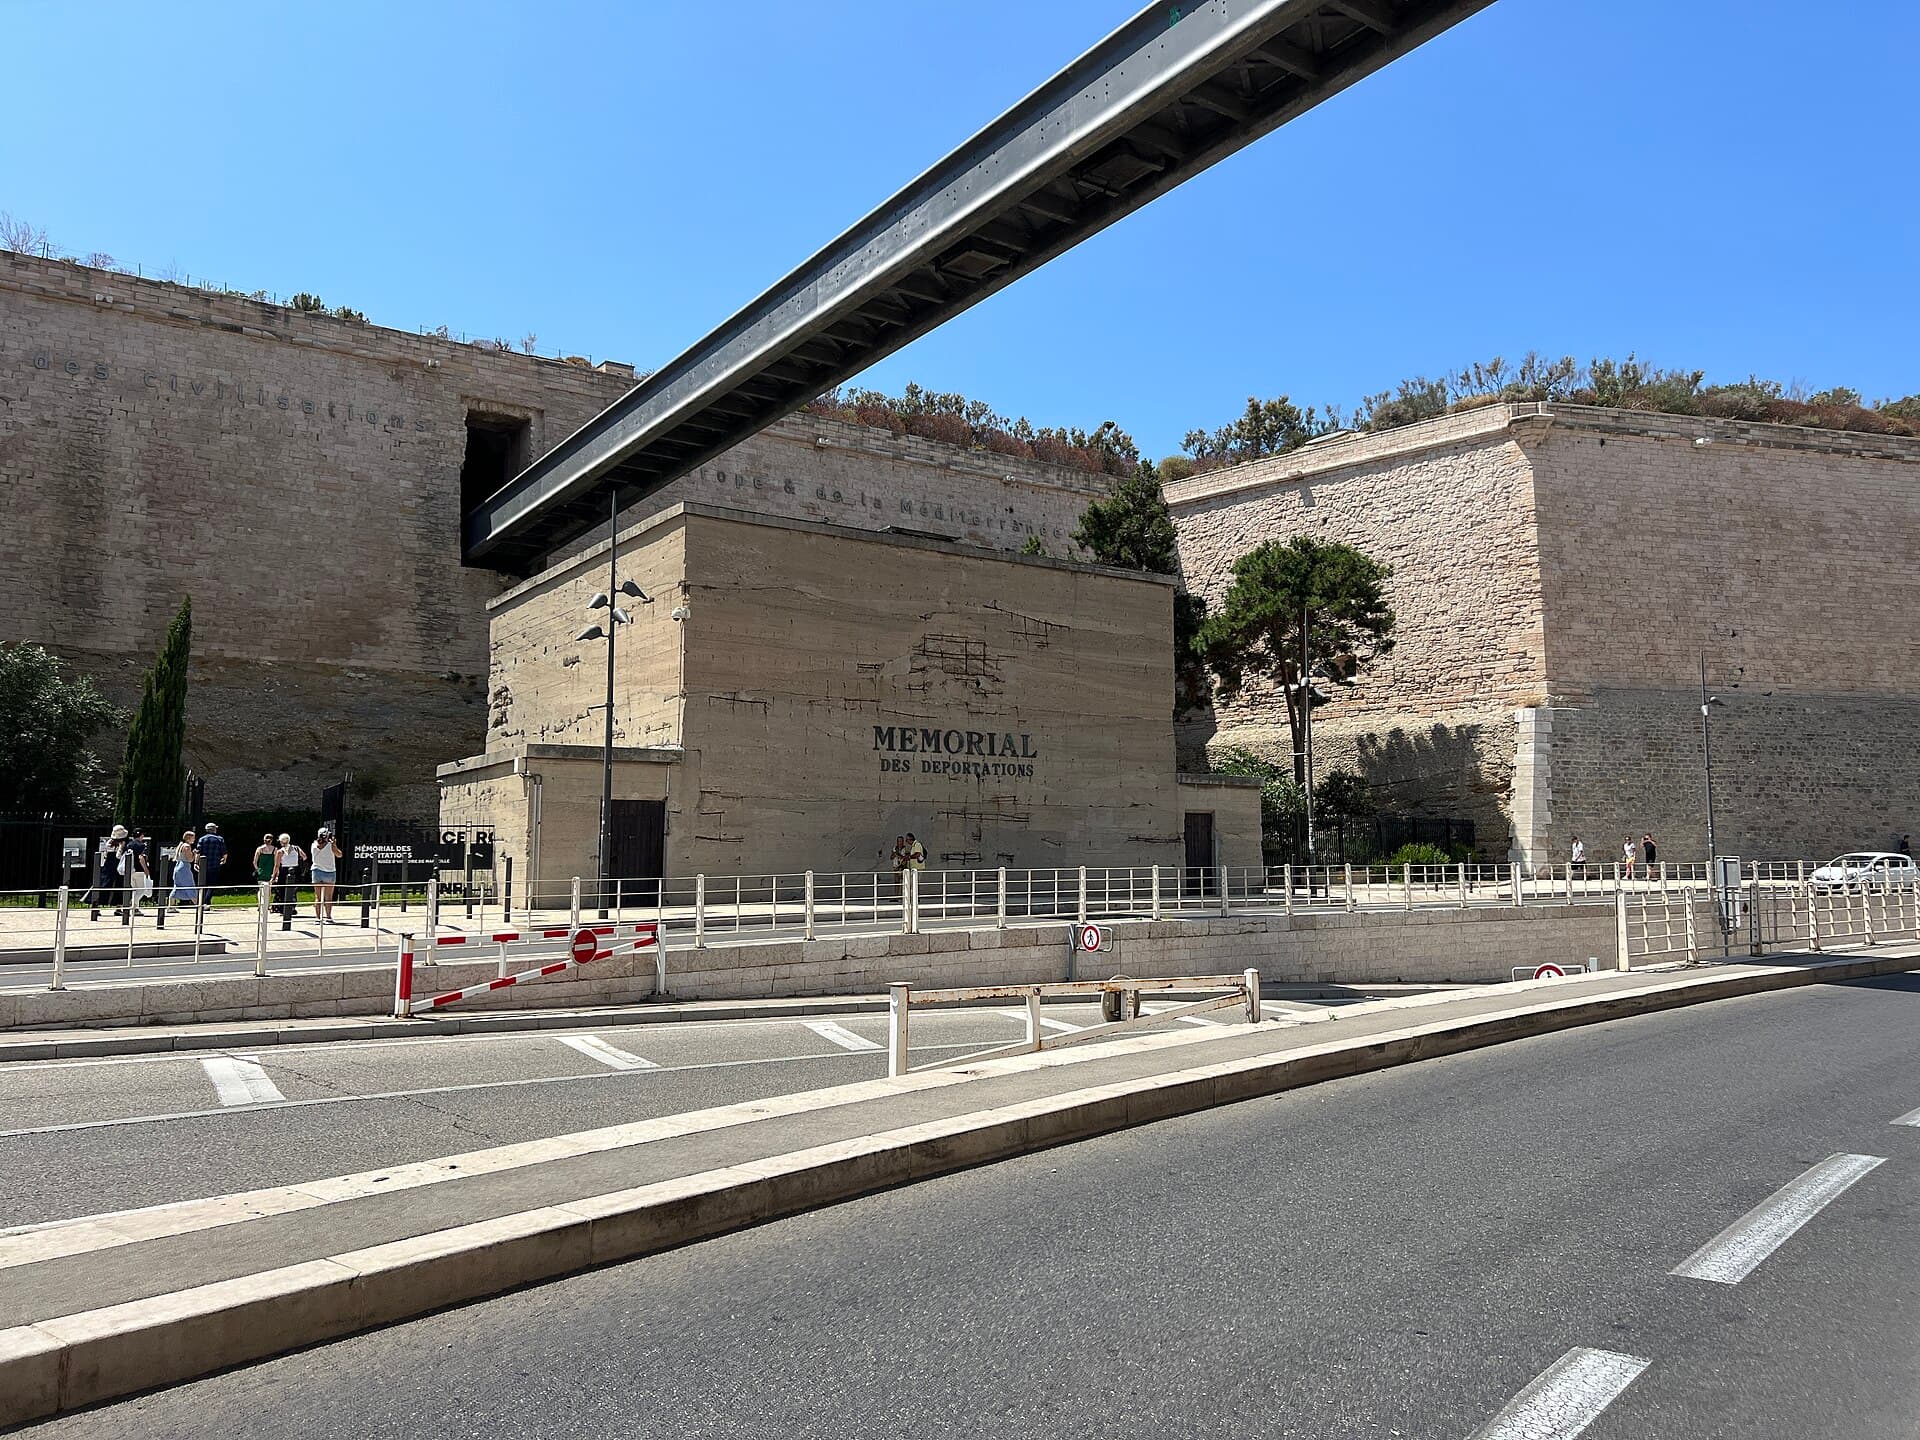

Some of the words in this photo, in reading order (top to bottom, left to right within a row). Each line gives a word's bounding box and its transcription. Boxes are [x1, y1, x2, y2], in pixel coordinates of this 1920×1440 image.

[33, 348, 111, 381] des
[143, 371, 428, 432] civilisations
[872, 725, 1038, 759] MEMORIAL
[880, 758, 911, 773] DES
[921, 760, 1034, 777] DEPORTATIONS
[354, 844, 396, 852] MÉMORIAL
